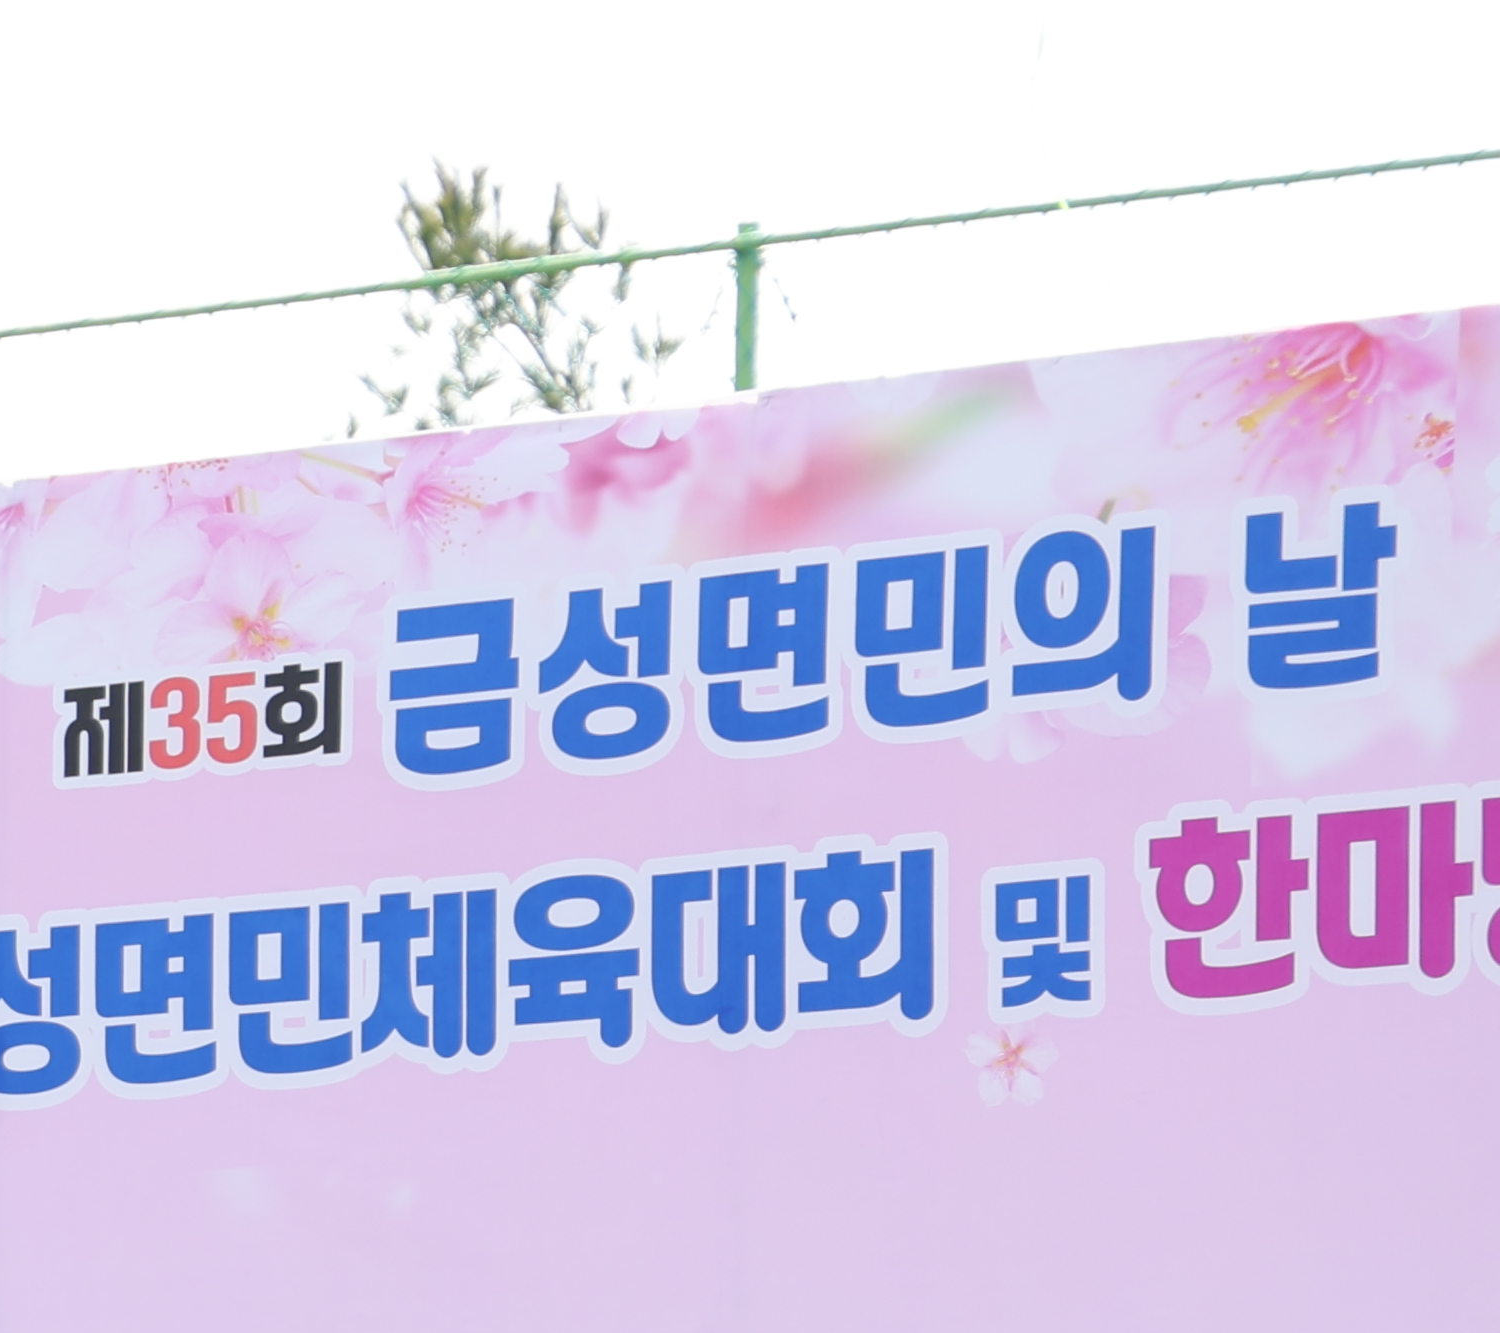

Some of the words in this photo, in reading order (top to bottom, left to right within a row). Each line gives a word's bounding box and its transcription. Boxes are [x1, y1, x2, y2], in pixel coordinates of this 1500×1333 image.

[63, 661, 343, 778] 제35회
[390, 525, 1154, 776] 금성면민의
[1244, 501, 1397, 690] 날
[995, 874, 1091, 1008] 및
[1148, 796, 1500, 1000] 한마
